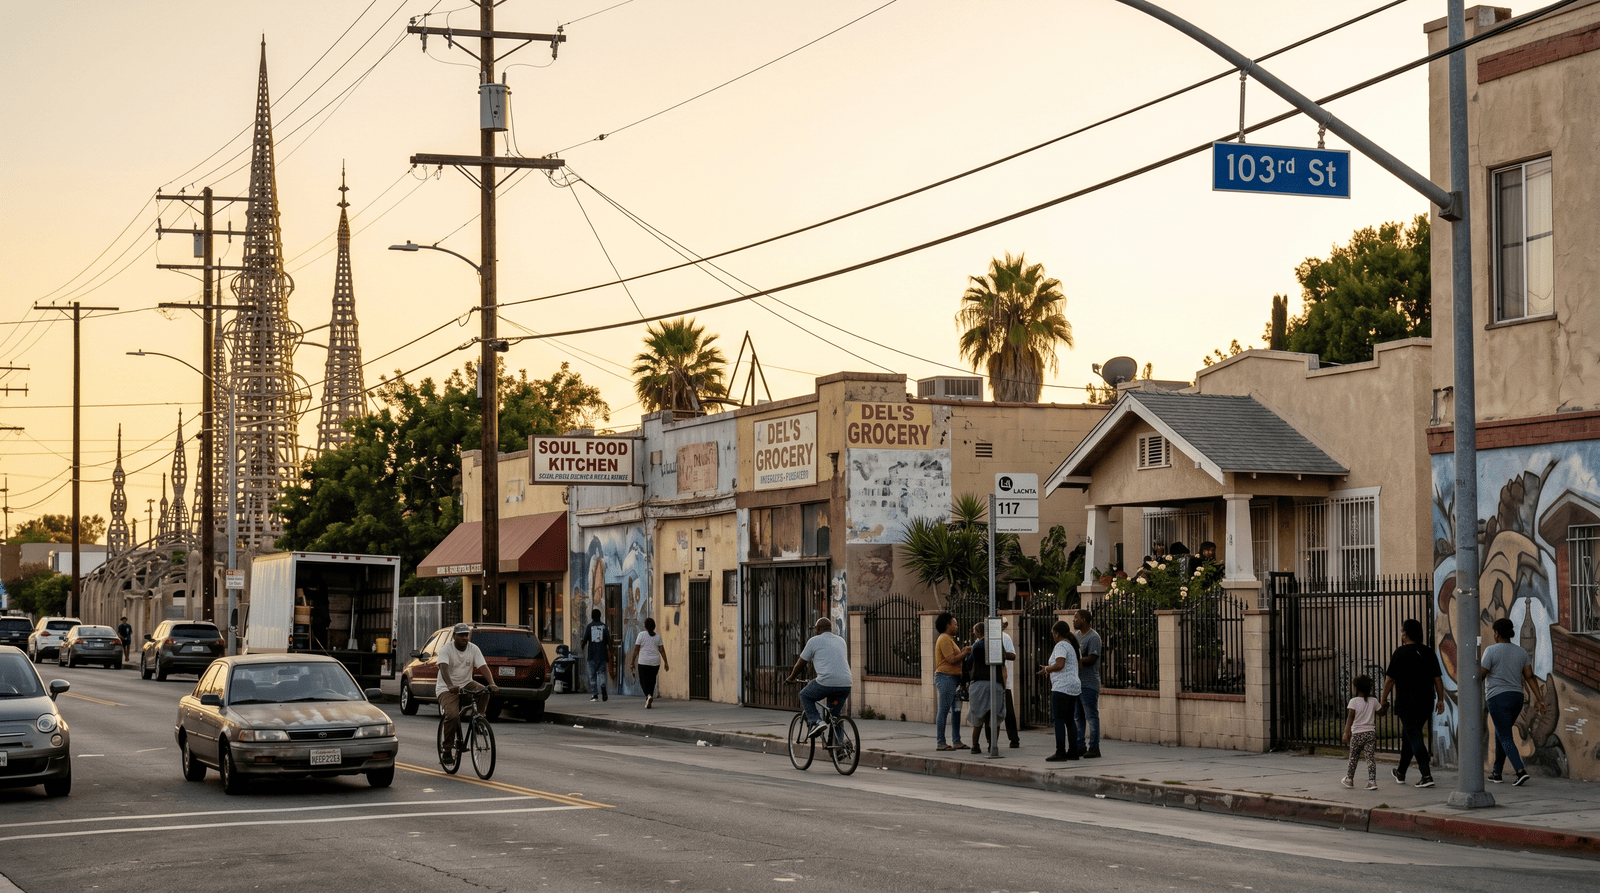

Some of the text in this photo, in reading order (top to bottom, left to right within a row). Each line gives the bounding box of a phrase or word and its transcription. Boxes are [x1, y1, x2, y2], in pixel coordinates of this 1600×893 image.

[1227, 153, 1337, 188] 103rd St
[861, 404, 915, 421] DEL'S
[767, 418, 801, 445] DEL'S
[847, 422, 931, 446] GROCERY
[538, 440, 628, 456] SOUL FOOD
[755, 442, 814, 472] GROCERY
[548, 457, 619, 472] KITCHEN
[998, 501, 1020, 515] 117
